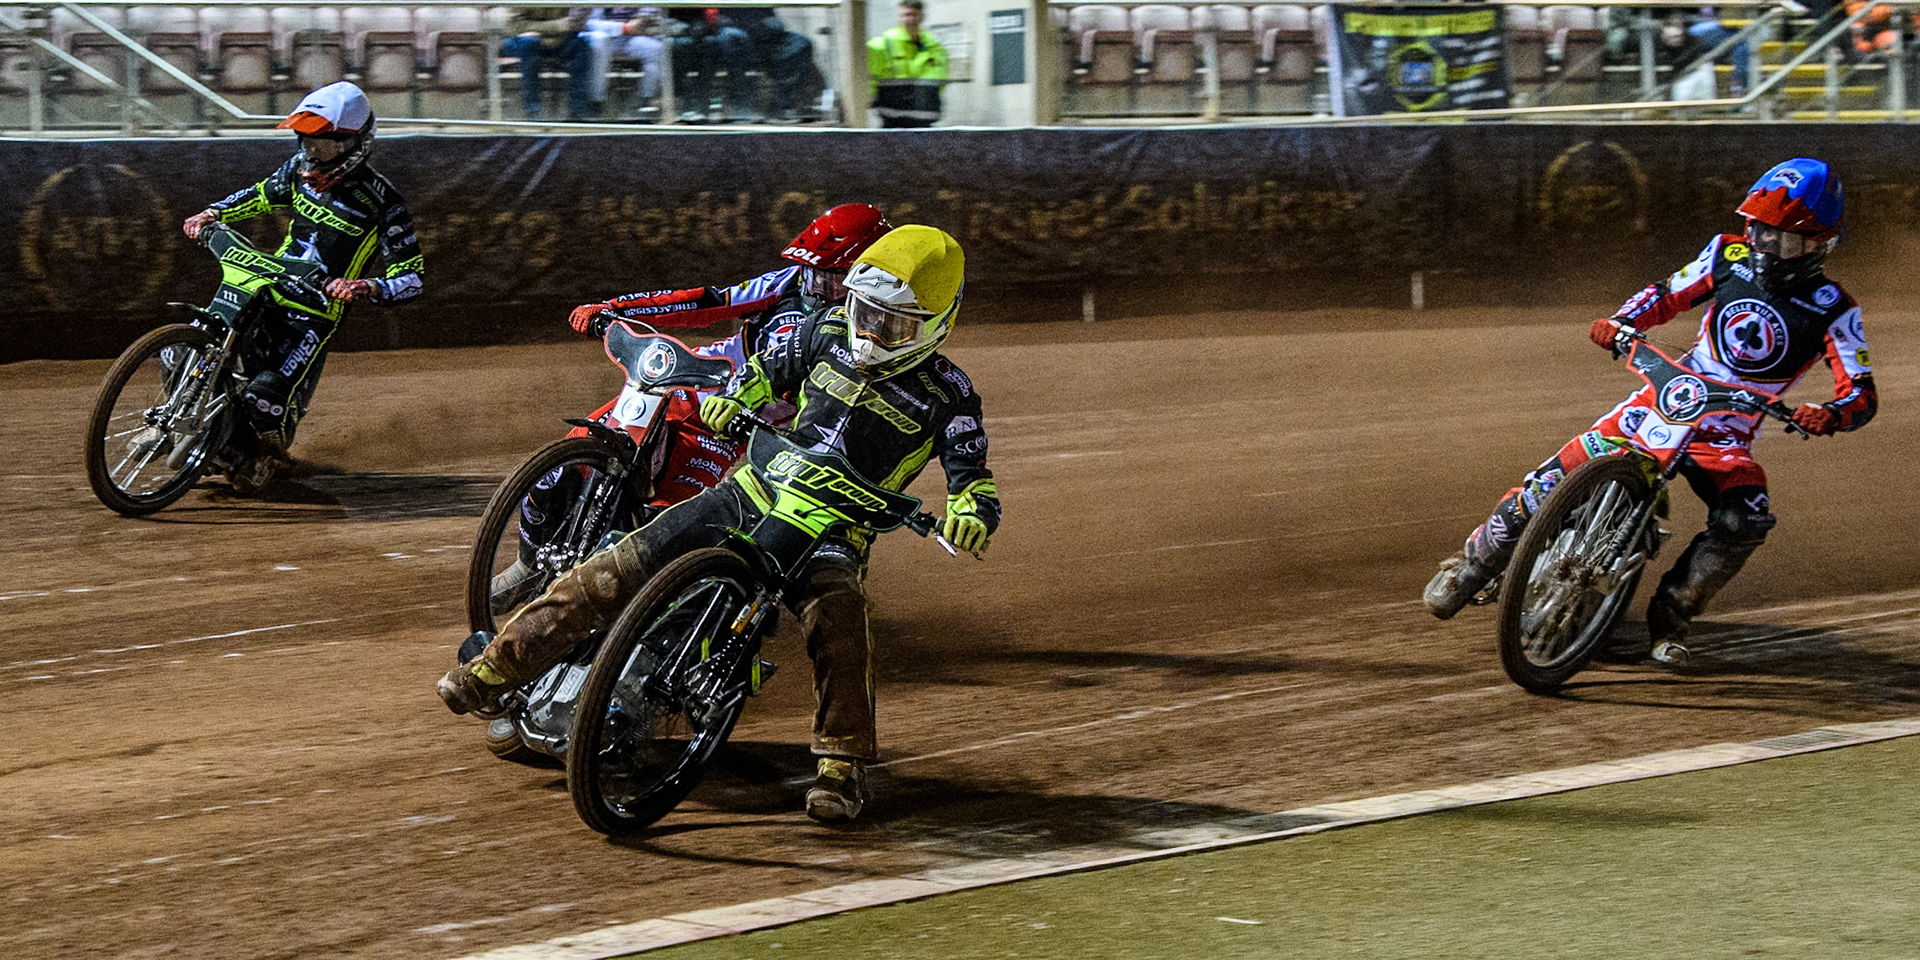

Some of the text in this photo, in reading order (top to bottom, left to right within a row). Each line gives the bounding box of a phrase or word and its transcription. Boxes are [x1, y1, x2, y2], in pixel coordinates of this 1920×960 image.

[220, 247, 259, 266] tru7
[783, 246, 822, 265] BOLL
[1724, 303, 1752, 319] BELLE
[1754, 304, 1774, 321] VUE
[1770, 322, 1785, 346] ACES
[829, 343, 858, 363] ROW
[809, 360, 922, 435] tru7 group
[701, 442, 731, 461] Hayes
[690, 457, 722, 476] Mobil
[766, 450, 888, 510] tru7 group
